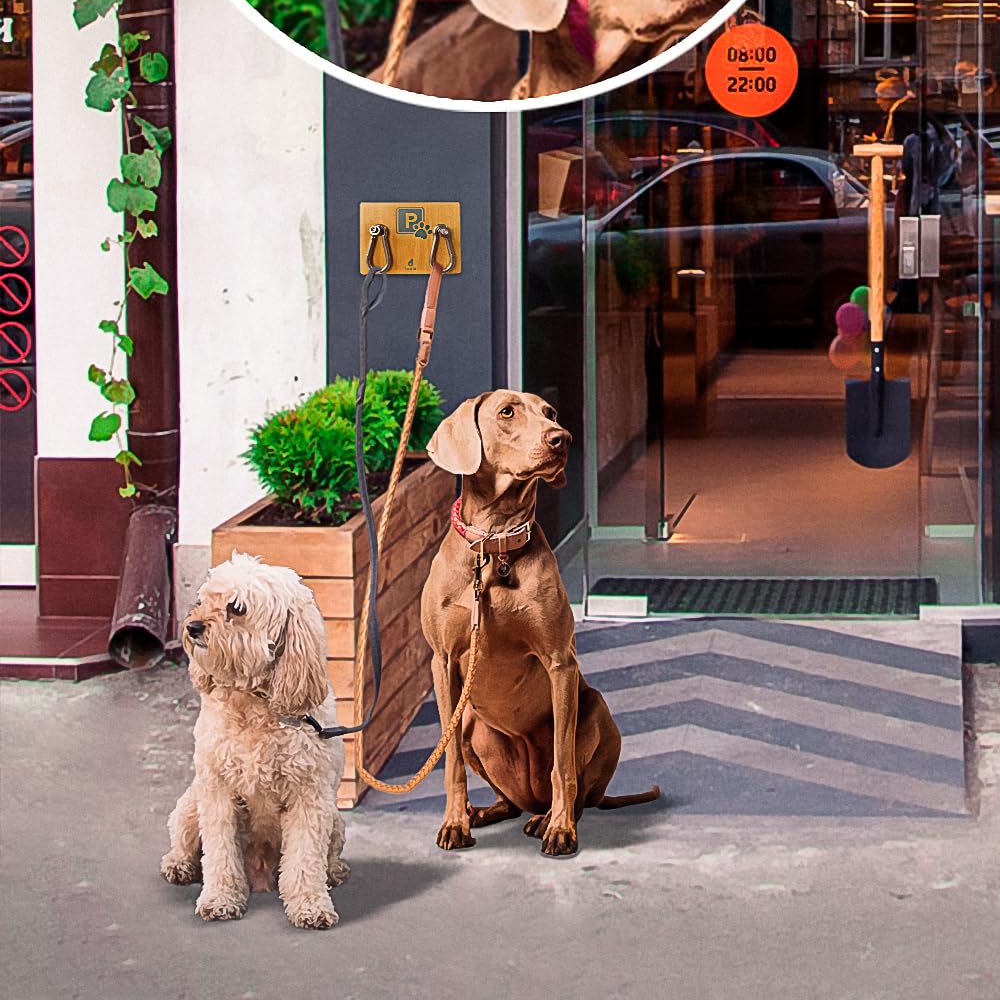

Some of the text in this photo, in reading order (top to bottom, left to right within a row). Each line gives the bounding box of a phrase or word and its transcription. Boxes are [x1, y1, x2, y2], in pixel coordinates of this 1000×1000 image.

[727, 47, 777, 62] 08:00
[727, 77, 777, 93] 22:00
[405, 212, 418, 229] P
